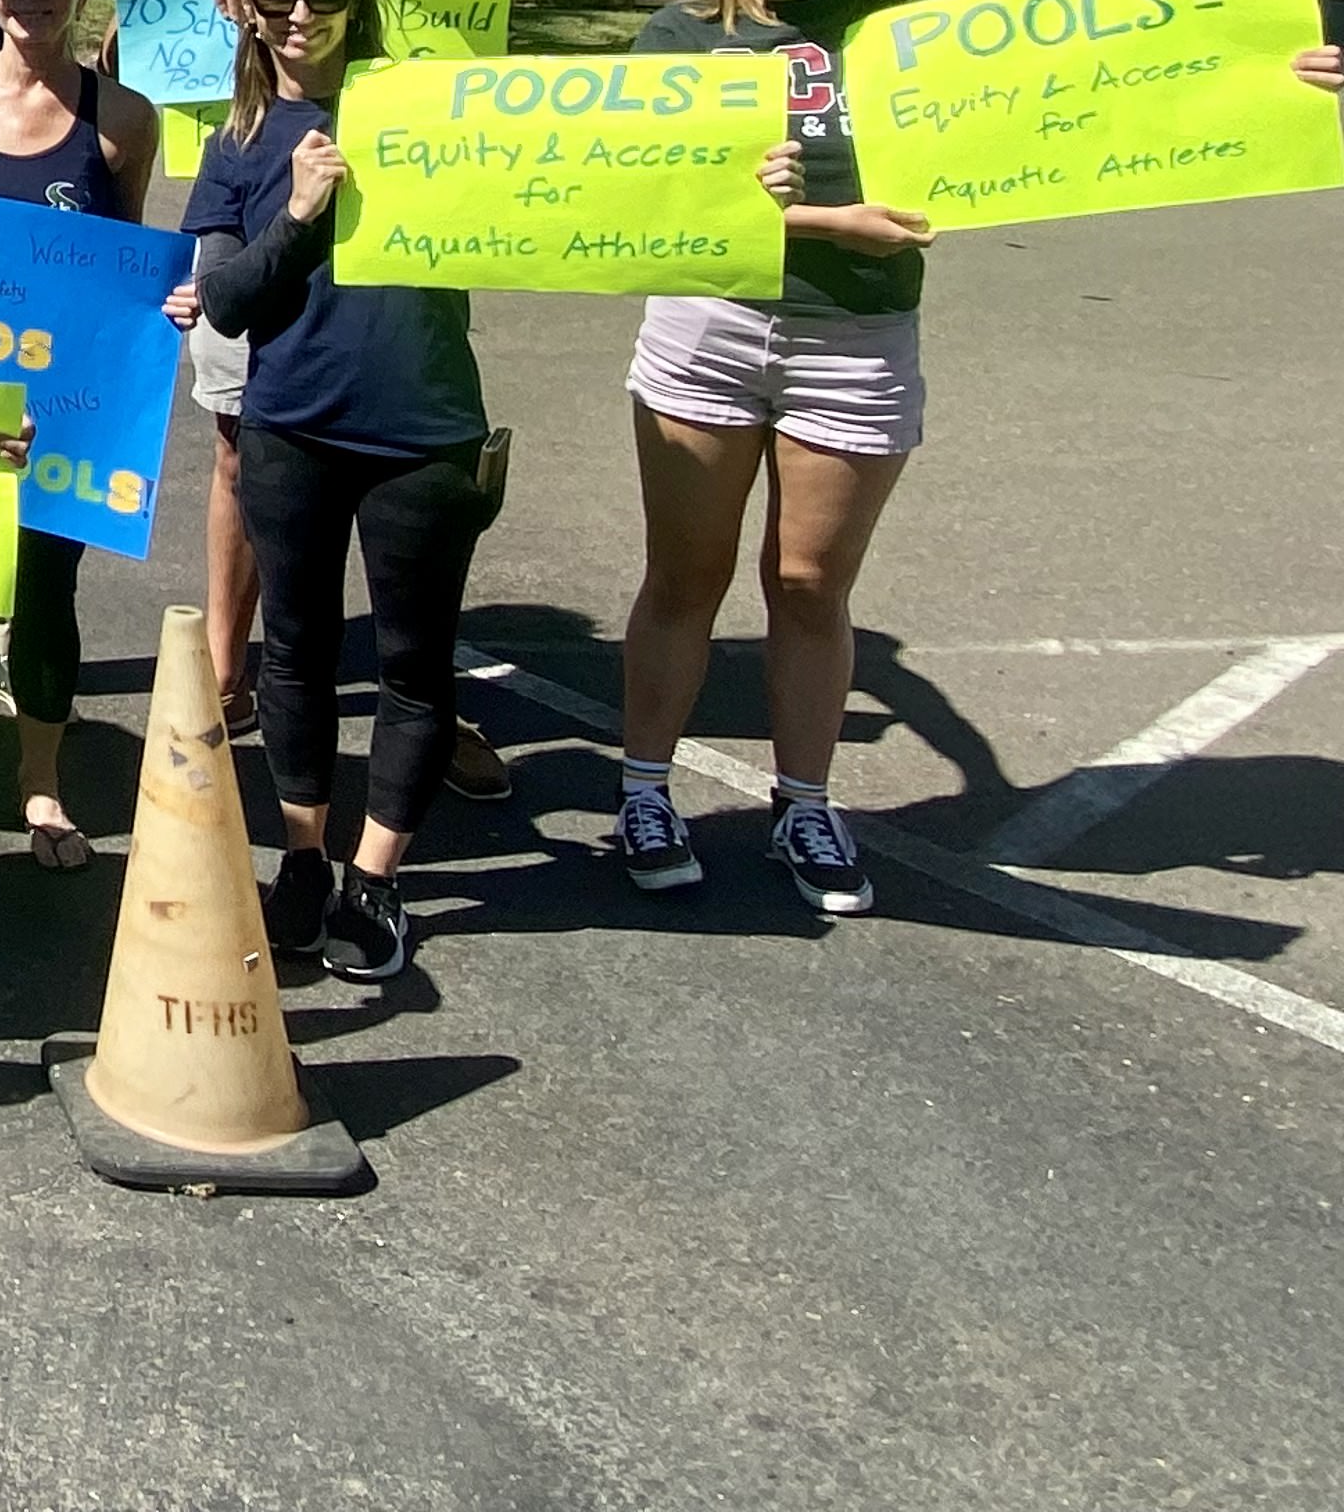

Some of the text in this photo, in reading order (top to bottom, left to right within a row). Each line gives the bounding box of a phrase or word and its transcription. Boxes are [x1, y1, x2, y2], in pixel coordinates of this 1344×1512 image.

[450, 64, 704, 121] POOLS
[890, 85, 1021, 133] Equity
[1041, 72, 1074, 100] &
[1091, 53, 1223, 93] Access
[375, 128, 732, 179] Equity & Access
[928, 138, 1249, 209] Aquatic Athletes
[513, 176, 583, 208] for
[29, 232, 161, 279] Water Polo
[382, 224, 730, 271] Aquatic Athletes
